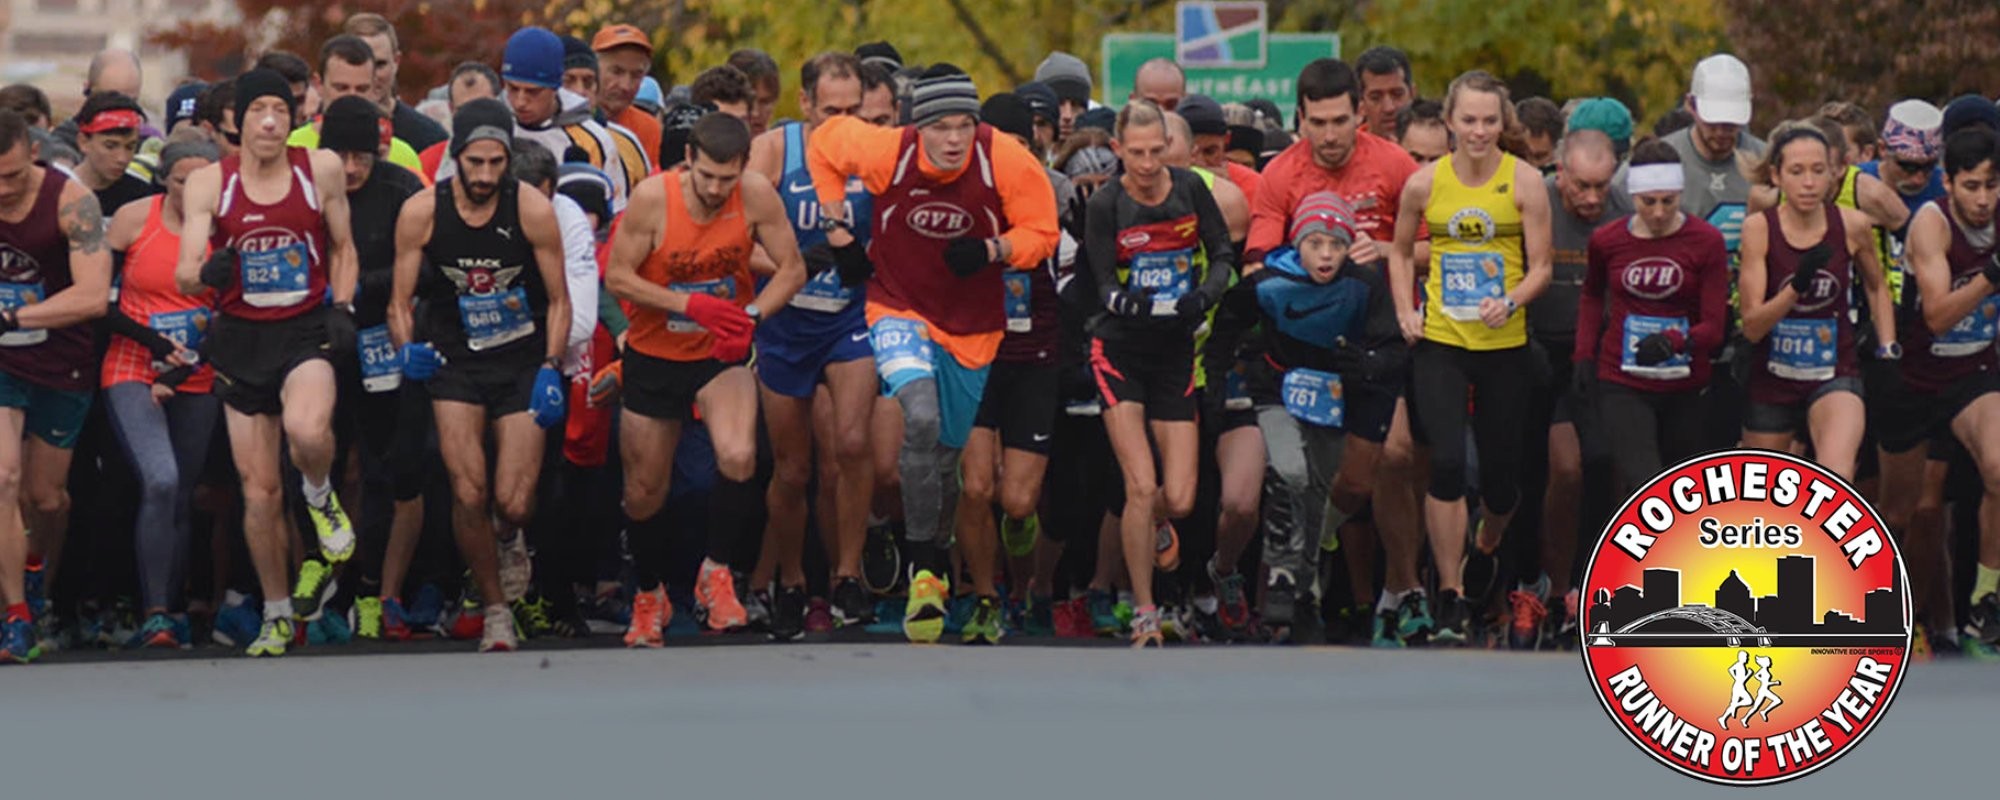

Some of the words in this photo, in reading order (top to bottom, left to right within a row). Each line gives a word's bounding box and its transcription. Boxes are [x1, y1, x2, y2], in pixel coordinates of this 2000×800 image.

[1186, 75, 1291, 97] UTHEAST
[913, 210, 964, 229] GVH
[457, 258, 502, 269] TRACK
[248, 265, 279, 283] 824
[1132, 268, 1172, 288] 1029
[1446, 272, 1475, 291] 838
[1628, 266, 1676, 286] GVH
[875, 330, 912, 352] 1037
[1774, 337, 1814, 355] 1014
[364, 342, 396, 365] 313
[1289, 386, 1317, 407] 761
